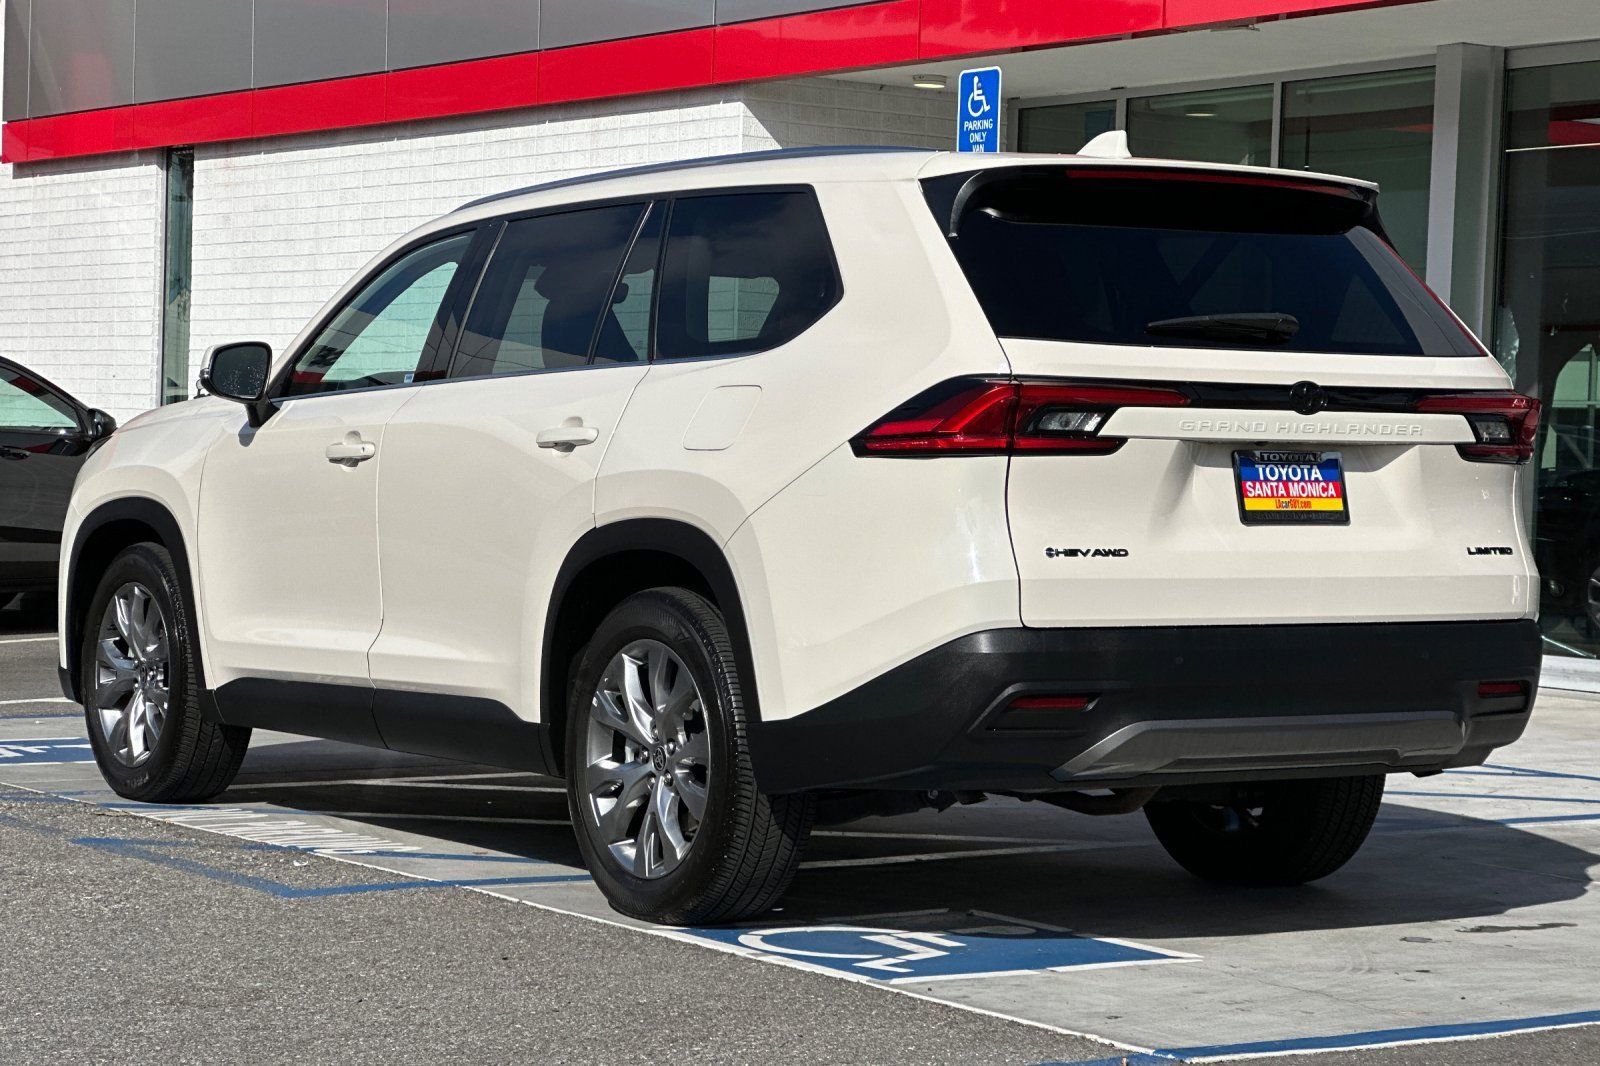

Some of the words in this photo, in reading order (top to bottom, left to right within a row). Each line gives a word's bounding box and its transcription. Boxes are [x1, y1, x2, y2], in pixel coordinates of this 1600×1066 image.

[964, 119, 993, 131] PARKING
[969, 132, 987, 143] ONLY
[972, 144, 985, 152] VAN
[1179, 420, 1267, 433] GRAND
[1275, 422, 1424, 436] HIGHLANDER
[1261, 453, 1314, 461] TOYOTA
[1255, 464, 1323, 481] TOYOTA
[1246, 481, 1287, 497] SANTA
[1288, 482, 1336, 498] MONICA
[1466, 546, 1513, 555] LIMITED
